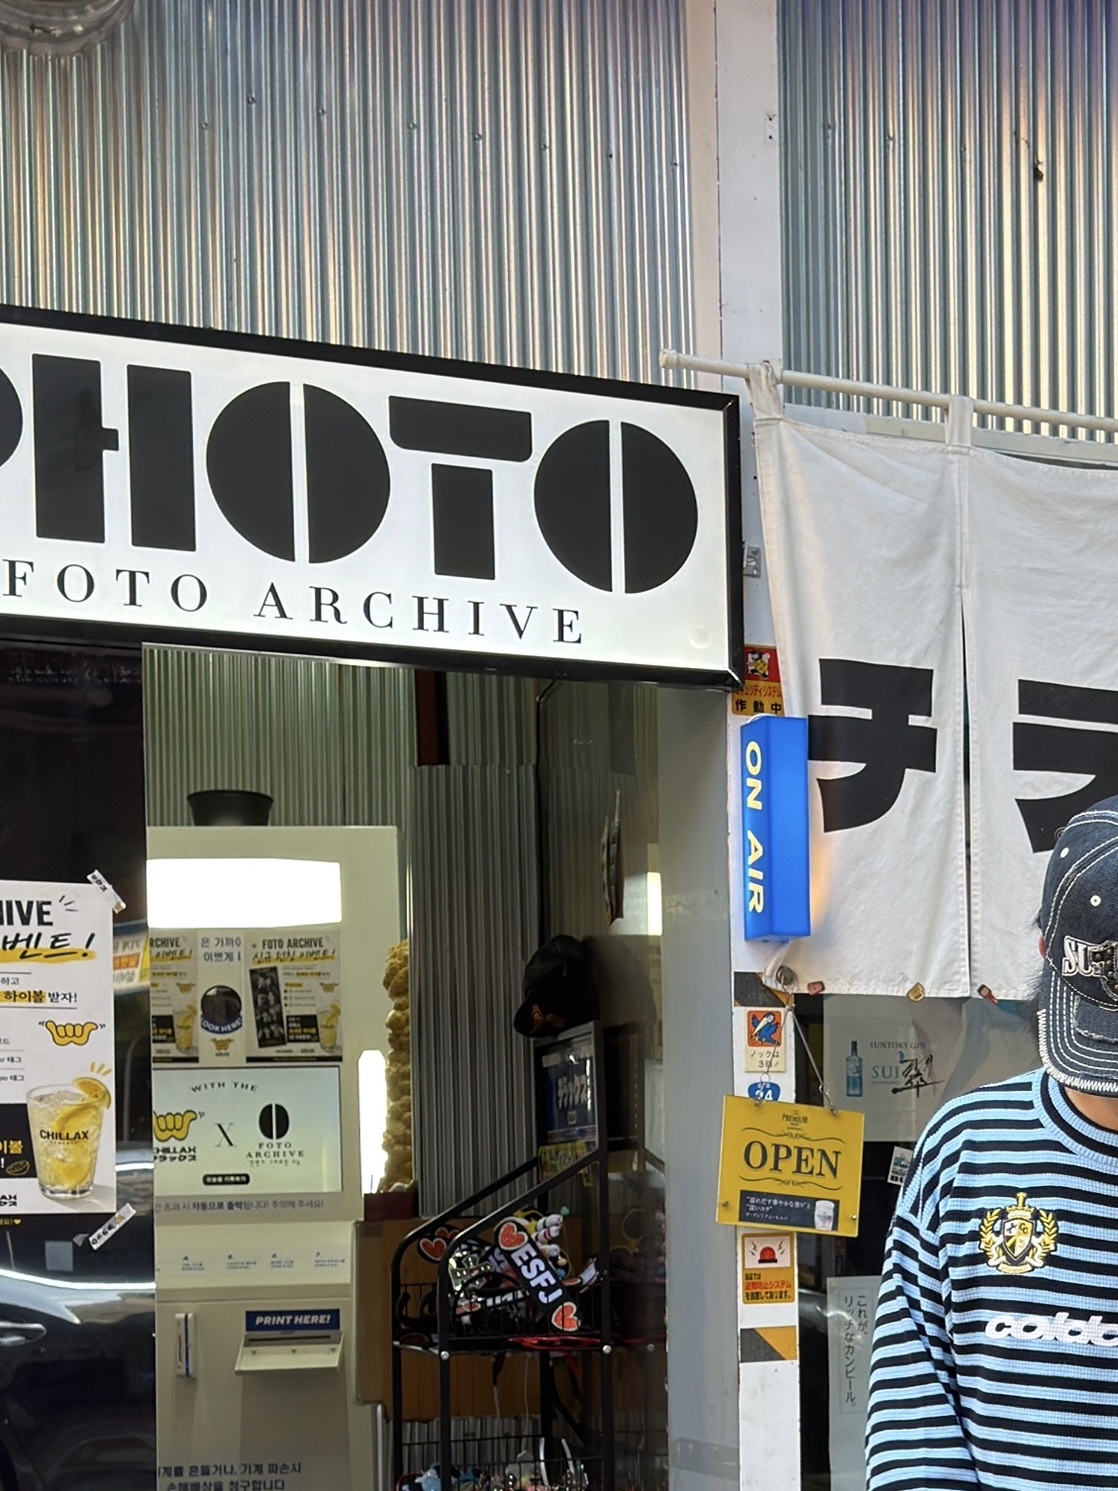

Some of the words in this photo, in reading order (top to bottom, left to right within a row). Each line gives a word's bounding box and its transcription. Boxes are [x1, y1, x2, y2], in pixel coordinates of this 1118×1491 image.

[2, 559, 209, 613] FOTO
[254, 581, 584, 645] ARCHIVE
[744, 740, 764, 812] ON
[745, 836, 766, 916] AIR
[261, 938, 284, 950] FOTO
[287, 937, 324, 949] ARCHIVE
[48, 992, 78, 1004] 받자!
[869, 1041, 908, 1050] SUNTORY
[910, 1041, 927, 1050] GIN
[872, 1064, 899, 1080] SUI
[190, 1082, 226, 1093] WITH
[232, 1081, 258, 1093] THE
[39, 1129, 89, 1141] CHILLAX
[257, 1141, 292, 1150] FOTO
[245, 1149, 305, 1159] ARCHIVE
[743, 1140, 842, 1179] OPEN
[509, 1241, 564, 1305] ESFJ
[255, 1315, 292, 1326] PRINT
[294, 1313, 332, 1325] HERE!
[240, 1462, 264, 1475] 기계
[267, 1461, 302, 1475] 파손시
